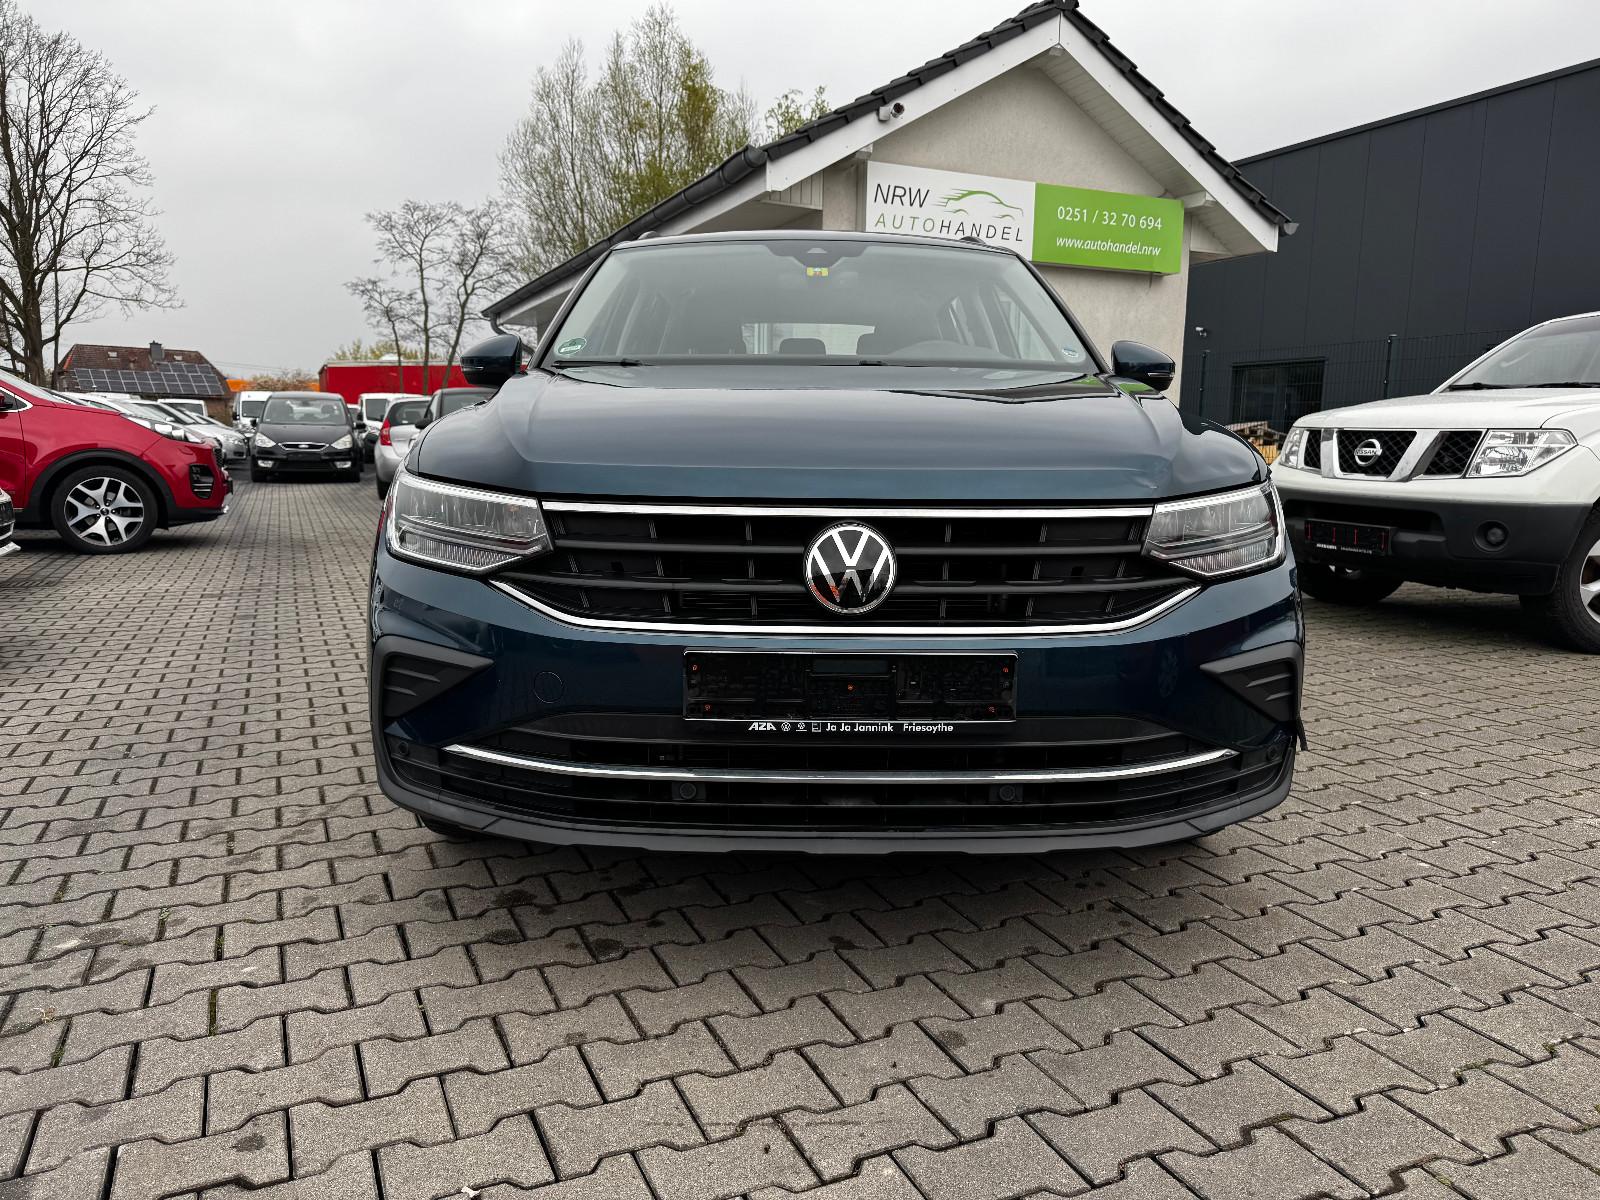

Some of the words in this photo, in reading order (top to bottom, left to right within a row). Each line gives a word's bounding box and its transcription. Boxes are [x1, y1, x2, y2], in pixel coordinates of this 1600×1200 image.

[874, 183, 930, 208] NRW
[875, 212, 1023, 242] AUTOHANDEL
[1057, 206, 1087, 223] 0251
[1092, 210, 1099, 223] /
[1102, 211, 1117, 226] 32
[1121, 213, 1136, 228] 70
[1139, 215, 1162, 230] 694
[1056, 236, 1161, 256] www.autohandel.nrw
[748, 722, 777, 731] AZA
[826, 722, 837, 732] Ja
[840, 722, 851, 732] Ja
[854, 722, 894, 732] Jannink
[903, 723, 954, 733] Friesoythe
